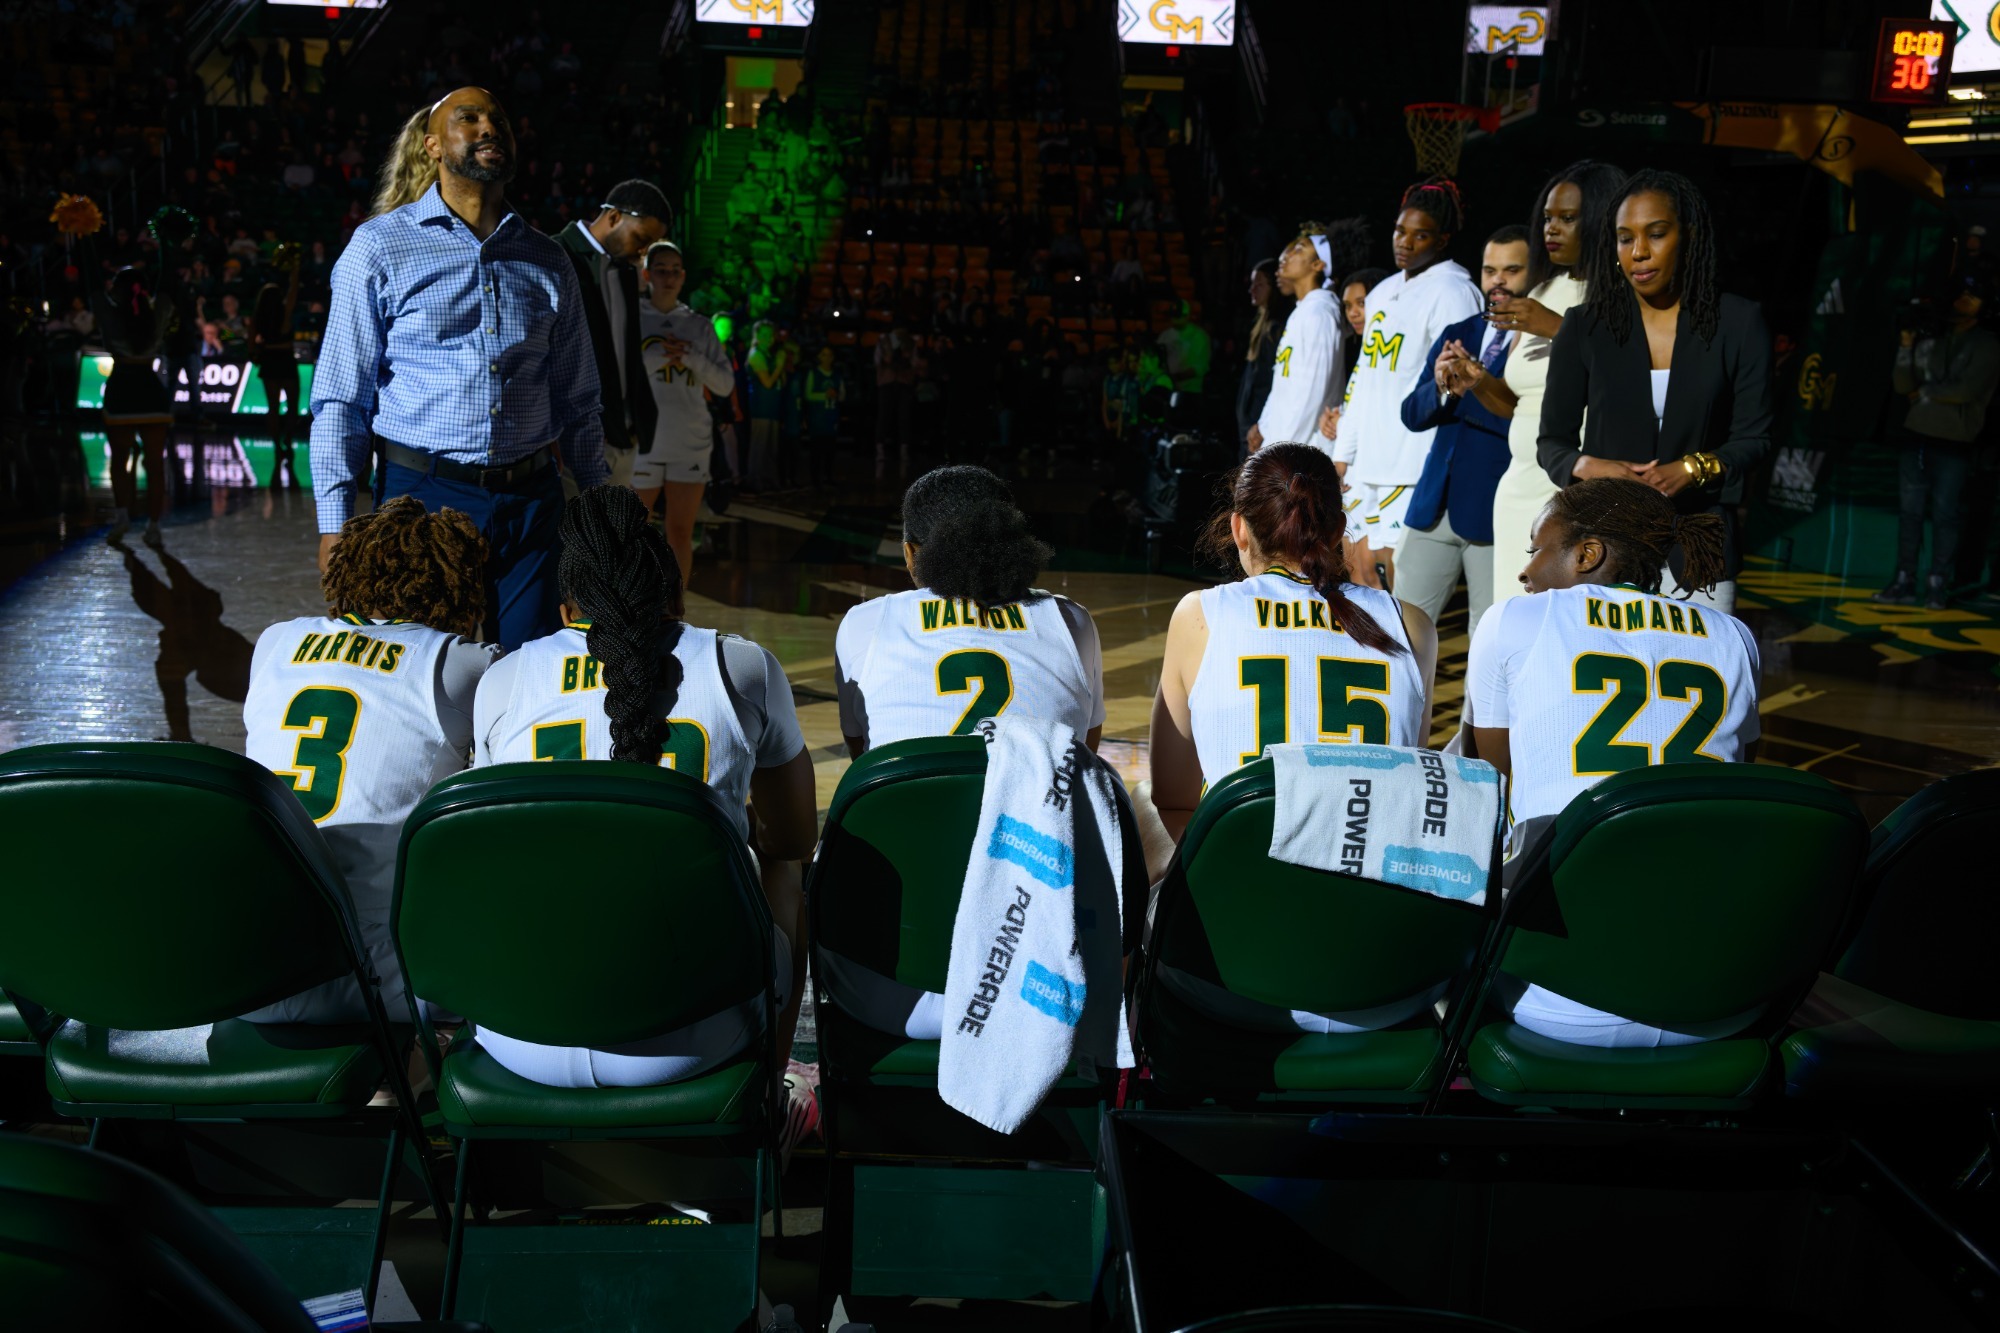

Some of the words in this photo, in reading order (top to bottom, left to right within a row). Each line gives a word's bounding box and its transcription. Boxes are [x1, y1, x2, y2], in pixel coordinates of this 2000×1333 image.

[1149, 0, 1203, 44] GM
[1893, 31, 1944, 57] 10:00
[1892, 57, 1930, 90] 30
[1609, 111, 1668, 126] Sentara
[1363, 311, 1405, 373] GM
[1586, 597, 1709, 638] KOMARA
[291, 630, 406, 673] HARRIS
[1238, 655, 1390, 760] 15
[1572, 651, 1728, 777] 22
[273, 685, 362, 824] 3
[1389, 860, 1472, 884] POWERADE
[957, 885, 1032, 1038] POWERADE
[648, 1217, 703, 1226] MASON
